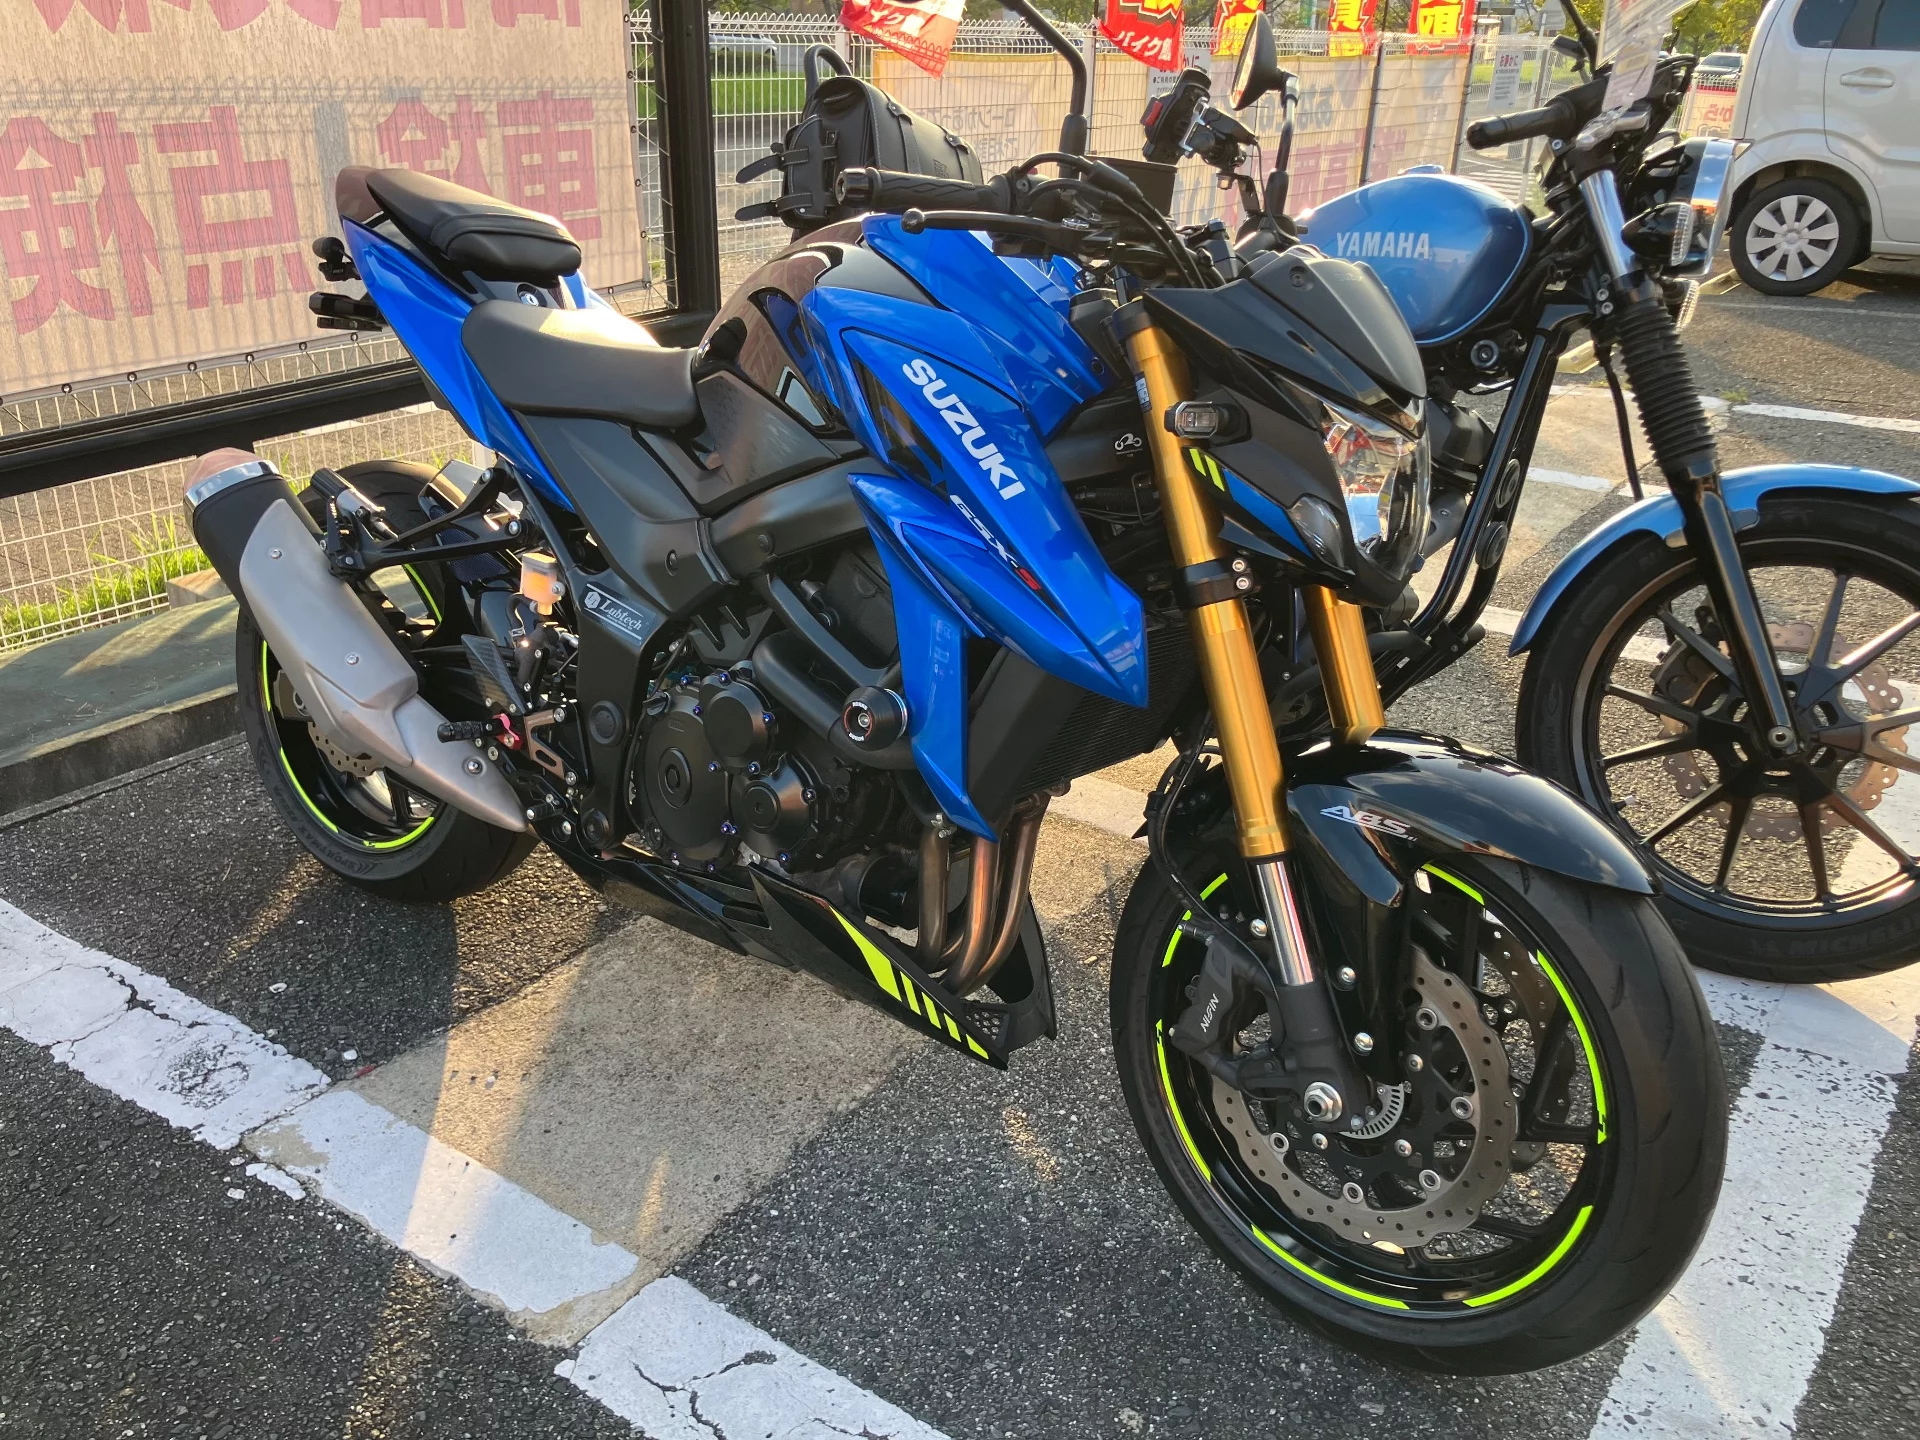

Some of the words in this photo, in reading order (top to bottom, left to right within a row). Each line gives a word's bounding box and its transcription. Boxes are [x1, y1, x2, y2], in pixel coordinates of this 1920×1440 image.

[1336, 231, 1430, 259] YAMAHA
[902, 358, 1026, 501] SUZUKI
[949, 494, 1042, 592] GSX-S
[599, 599, 643, 631] Lubtech
[1320, 805, 1412, 837] ABS
